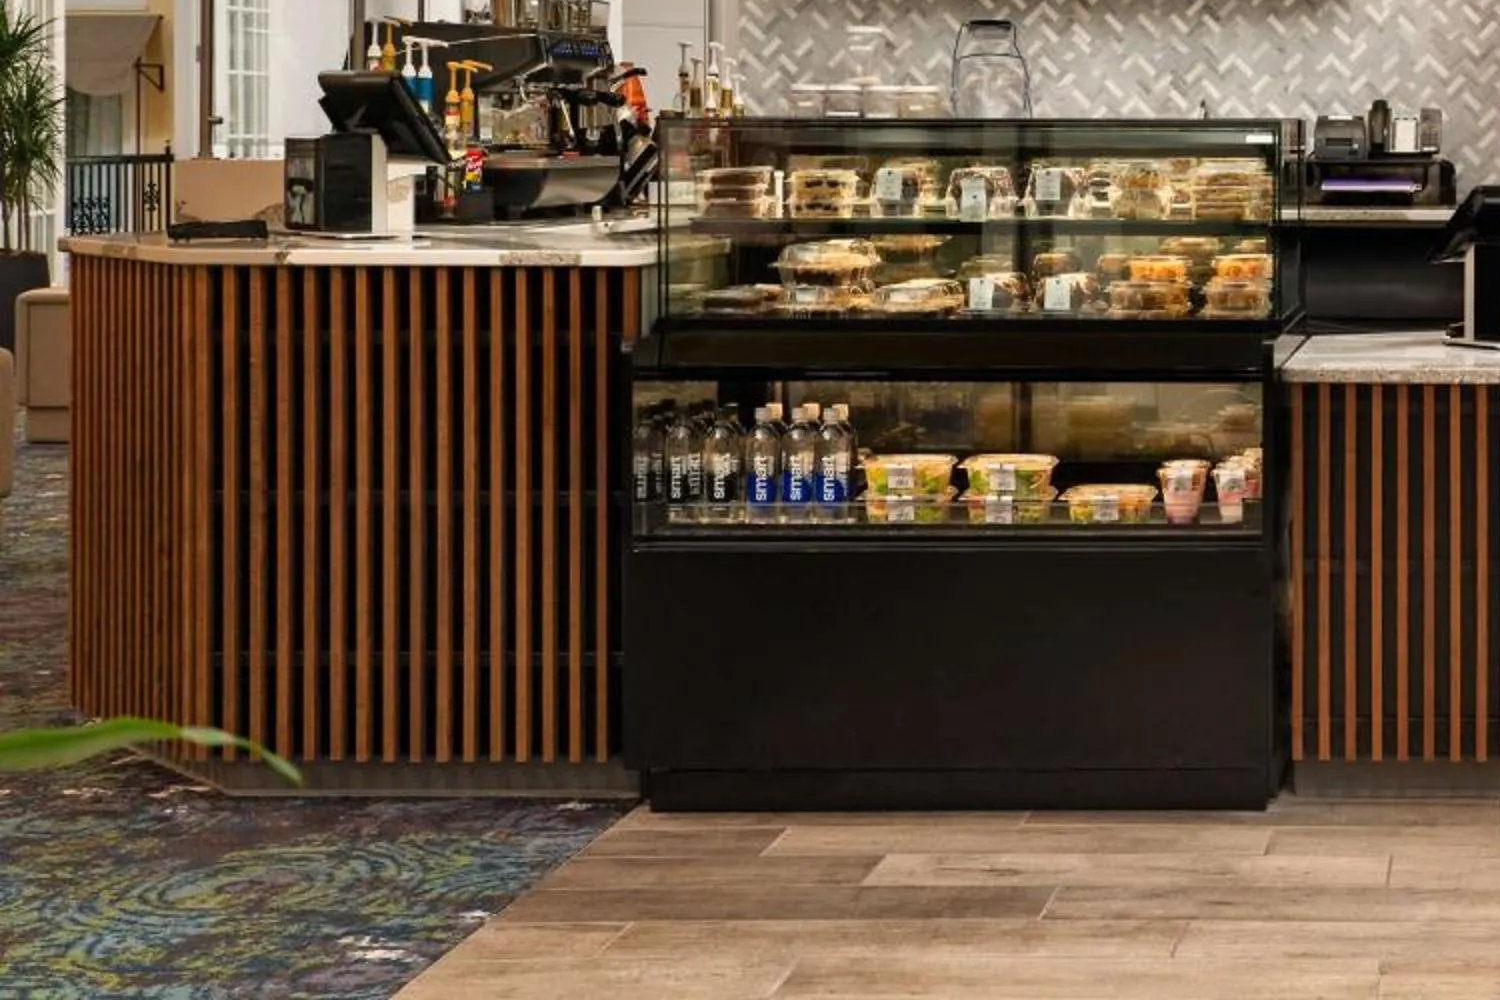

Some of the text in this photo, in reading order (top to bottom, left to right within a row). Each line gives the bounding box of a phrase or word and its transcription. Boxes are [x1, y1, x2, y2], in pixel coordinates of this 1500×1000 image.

[754, 455, 768, 501] smart
[790, 455, 803, 501] smart
[821, 455, 836, 502] smart
